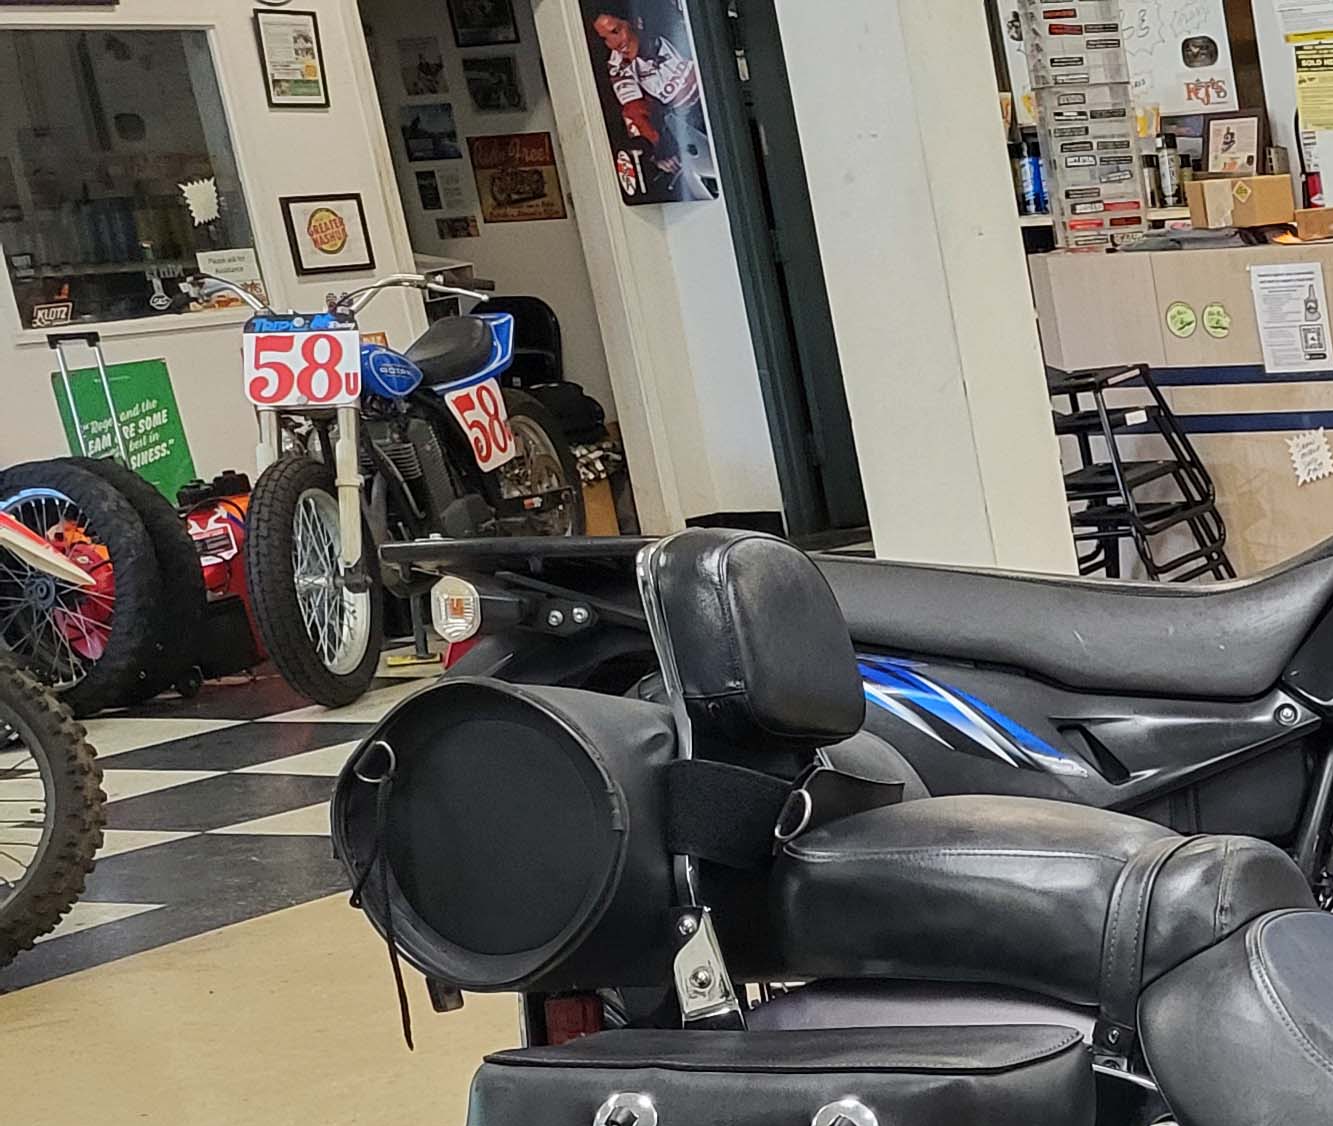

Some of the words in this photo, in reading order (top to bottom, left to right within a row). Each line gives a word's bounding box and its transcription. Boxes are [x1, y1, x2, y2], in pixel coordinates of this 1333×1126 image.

[37, 307, 67, 321] KLOTZ
[250, 333, 343, 404] 58
[345, 371, 358, 397] U
[119, 404, 140, 422] and
[141, 399, 157, 416] the
[137, 409, 168, 434] SOME
[451, 384, 508, 464] 58
